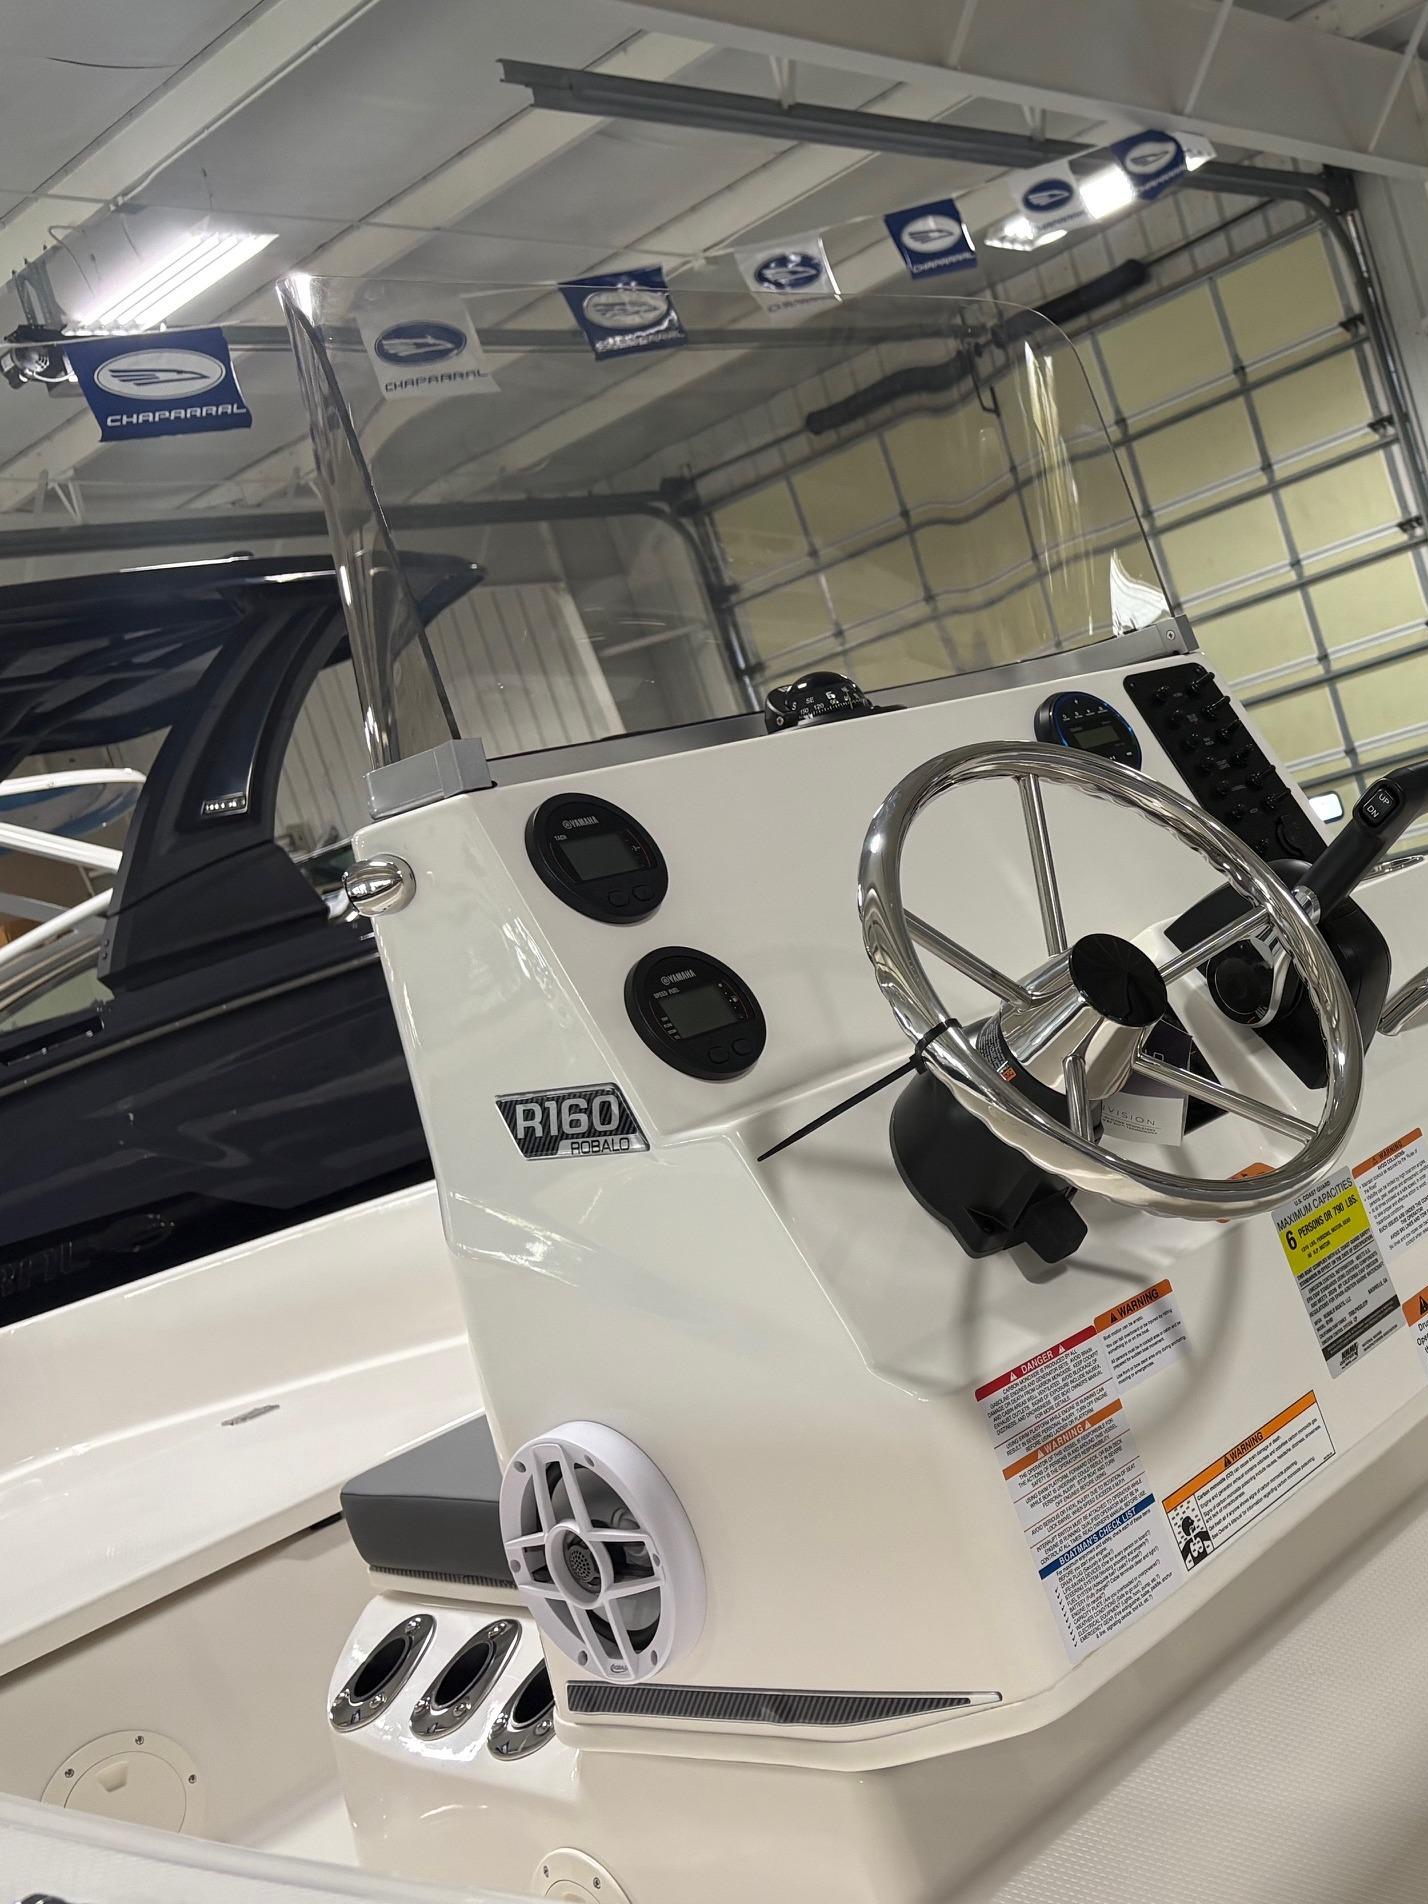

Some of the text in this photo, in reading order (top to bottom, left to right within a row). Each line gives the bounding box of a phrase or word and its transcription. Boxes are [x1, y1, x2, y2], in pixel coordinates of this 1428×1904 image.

[385, 368, 490, 393] CHAPARRAL
[106, 403, 248, 427] CHAPARRAL
[1366, 804, 1380, 818] DN
[1379, 793, 1390, 805] UP
[570, 815, 600, 828] YAMAHA
[668, 969, 697, 983] YAMAHA
[515, 1094, 620, 1139] R160
[570, 1137, 630, 1155] ROBALO
[1276, 1202, 1312, 1231] MAXIMUM
[1312, 1177, 1352, 1209] CAPACITIES
[1297, 1214, 1324, 1238] PERSONS
[1323, 1209, 1332, 1221] OR
[1285, 1229, 1298, 1250] 6
[1117, 1287, 1159, 1318] WARNING
[1020, 1350, 1053, 1374] DANGER
[1044, 1423, 1083, 1454] WARNING
[1228, 1431, 1263, 1462] WARNING
[1058, 1506, 1137, 1565] BOATMAN'S CHECK LIST
